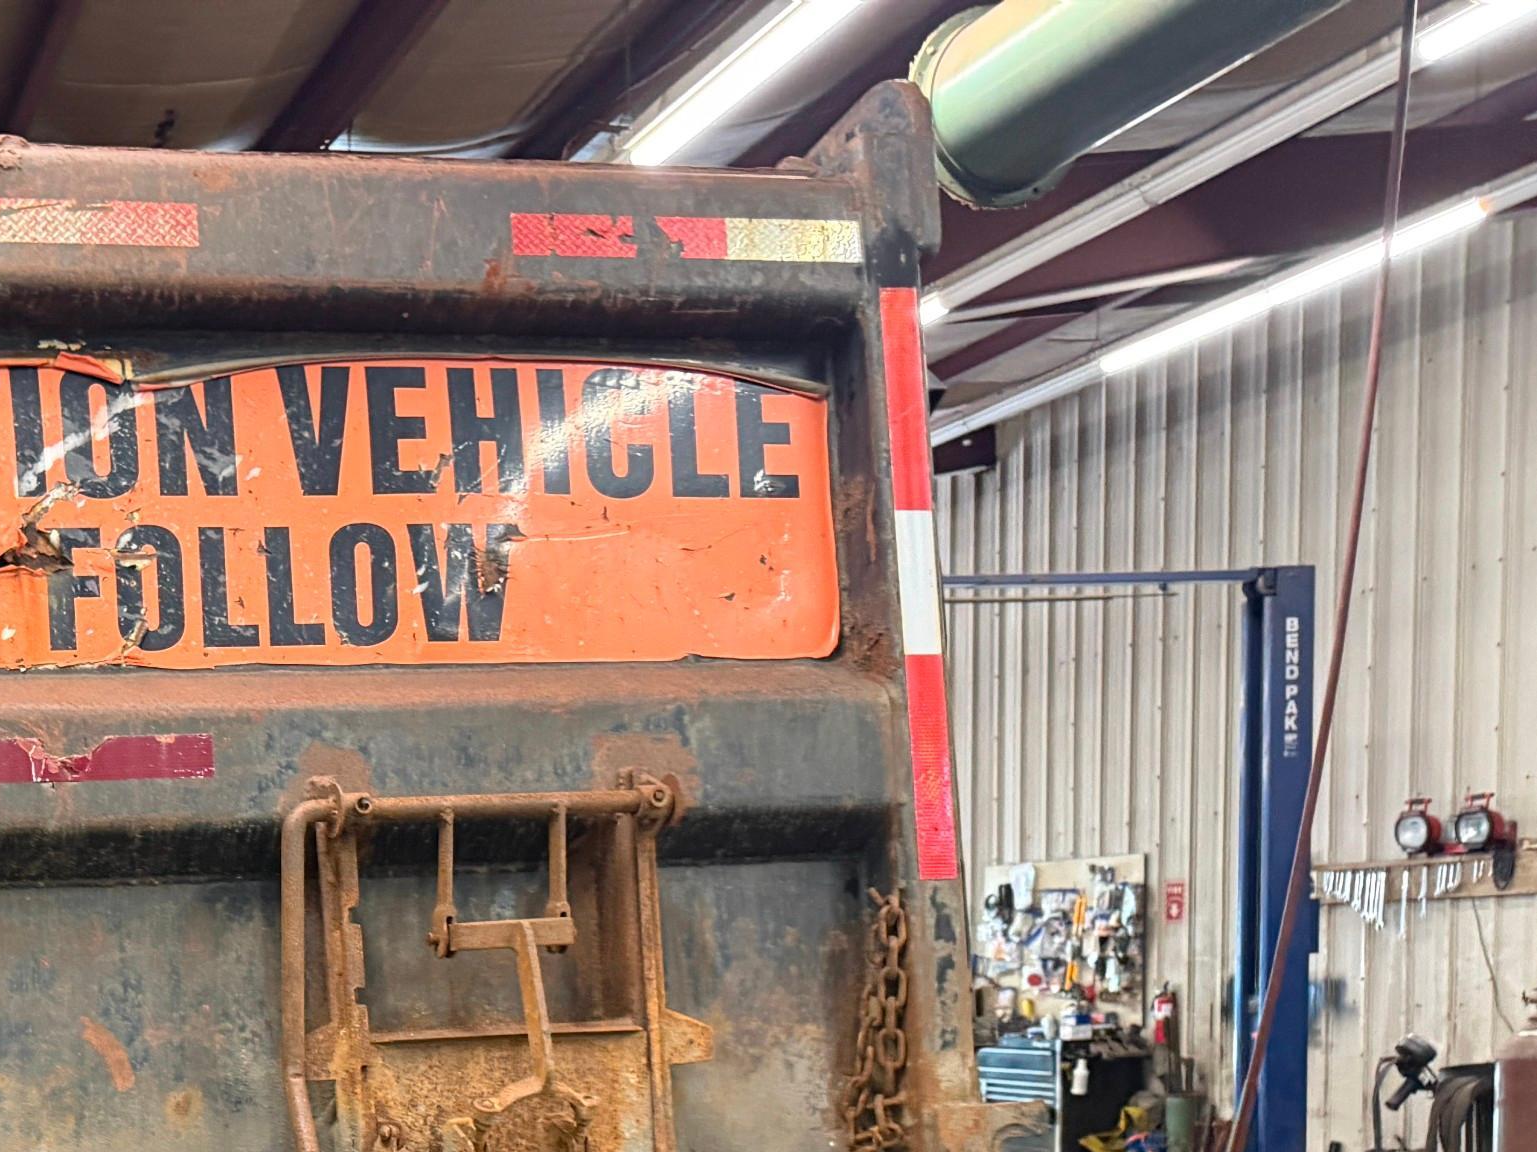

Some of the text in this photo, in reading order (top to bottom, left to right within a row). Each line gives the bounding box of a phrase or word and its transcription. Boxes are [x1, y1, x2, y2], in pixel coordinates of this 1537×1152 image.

[275, 364, 800, 499] VEHICLE
[48, 522, 517, 652] FOLLOW
[1284, 616, 1300, 681] BEND
[1284, 684, 1299, 731] PAK
